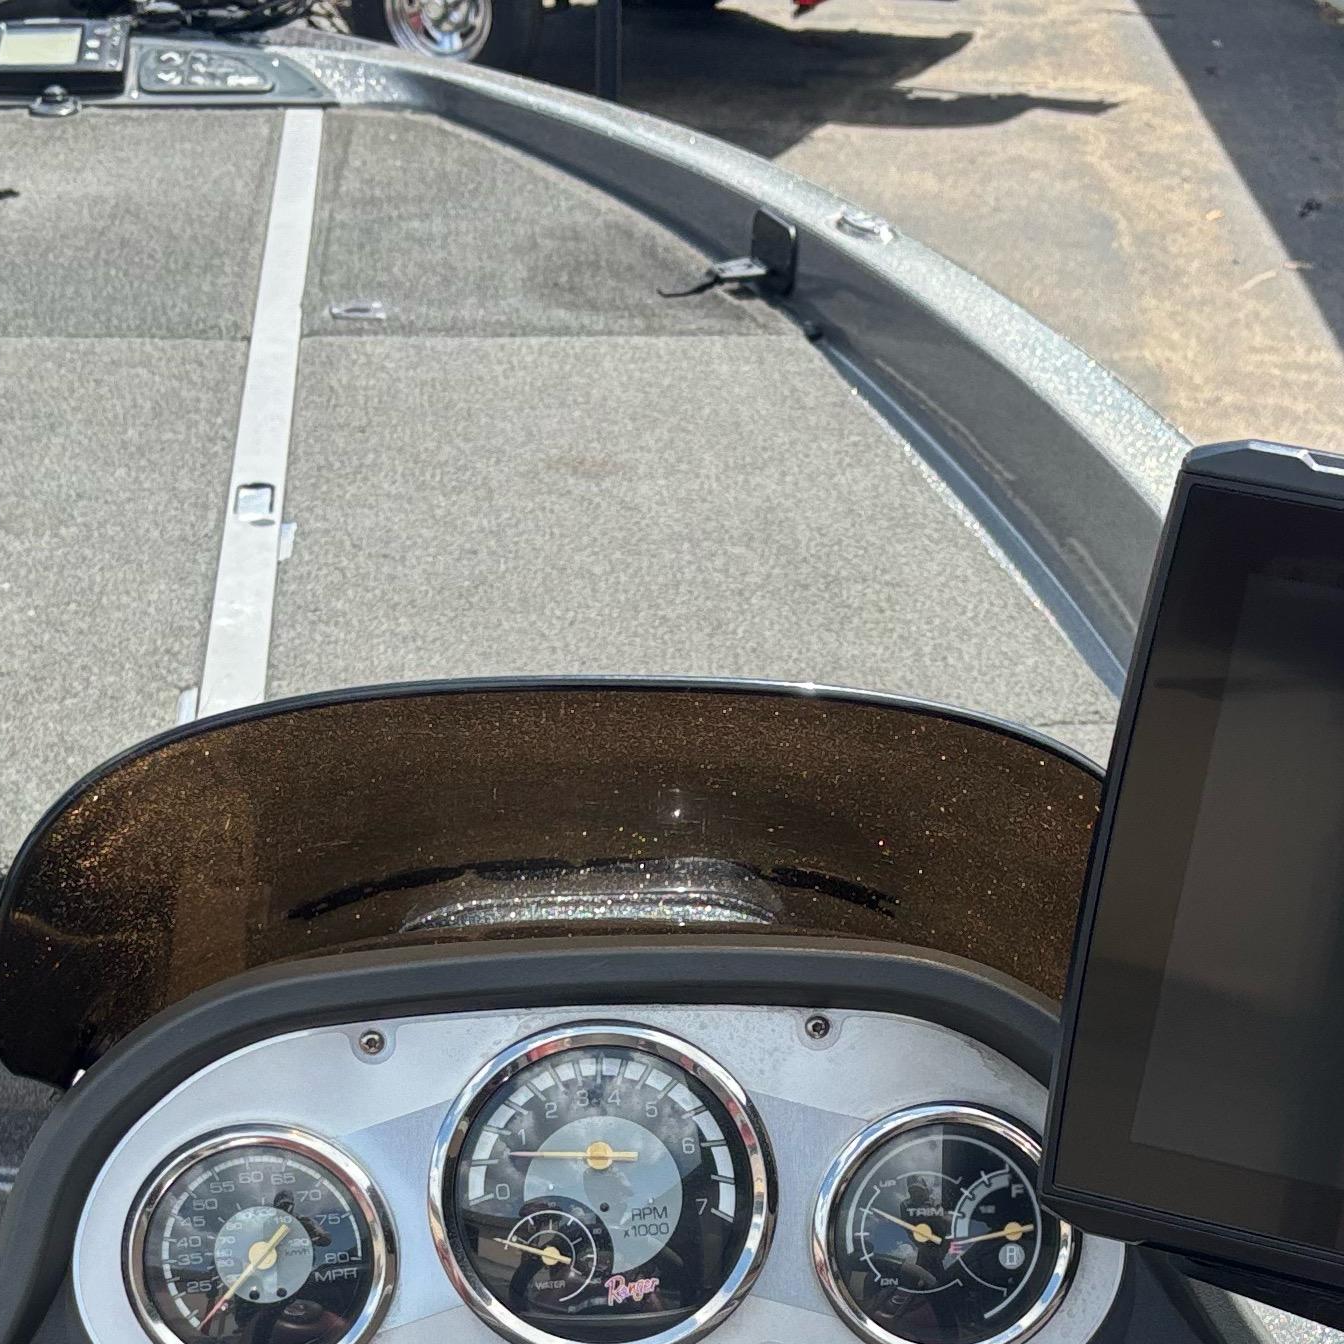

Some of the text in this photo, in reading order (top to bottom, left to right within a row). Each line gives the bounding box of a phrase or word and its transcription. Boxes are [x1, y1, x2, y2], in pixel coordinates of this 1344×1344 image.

[576, 1090, 589, 1107] 3
[608, 1089, 621, 1106] 4
[545, 1103, 558, 1119] 2
[645, 1102, 657, 1118] 5
[517, 1129, 526, 1145] 1
[682, 1138, 695, 1155] 6
[238, 1171, 264, 1184] 60
[270, 1173, 296, 1186] 65
[879, 1180, 897, 1188] UP
[209, 1180, 235, 1194] 55
[495, 1183, 510, 1200] 0
[1011, 1184, 1025, 1198] F
[296, 1189, 322, 1203] 70
[192, 1198, 218, 1211] 50
[696, 1198, 708, 1216] 7
[631, 1206, 668, 1222] RPM
[906, 1207, 944, 1217] TRIM
[180, 1215, 206, 1228] 45
[316, 1213, 341, 1226] 75
[623, 1222, 670, 1238] x1000
[176, 1235, 202, 1249] 40
[948, 1241, 962, 1255] E
[177, 1253, 204, 1266] 35
[324, 1252, 349, 1264] 80
[186, 1281, 212, 1294] 25
[880, 1278, 899, 1287] DN
[604, 1274, 659, 1306] Ranger
